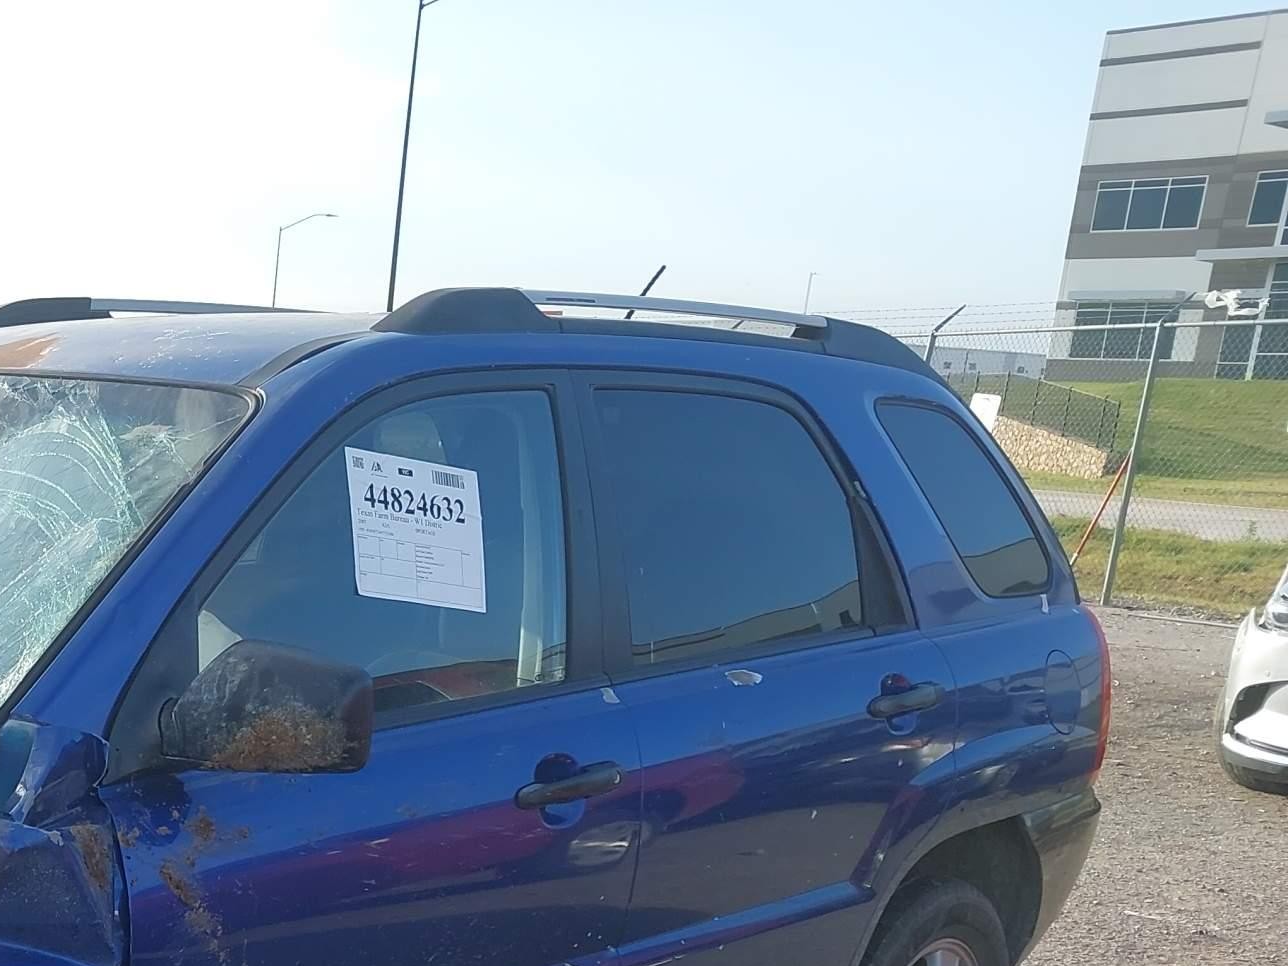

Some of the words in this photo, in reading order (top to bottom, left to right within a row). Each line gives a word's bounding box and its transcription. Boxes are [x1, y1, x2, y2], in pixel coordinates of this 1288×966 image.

[357, 507, 374, 517] Texas
[374, 510, 389, 521] Farm
[364, 483, 465, 524] 44824632
